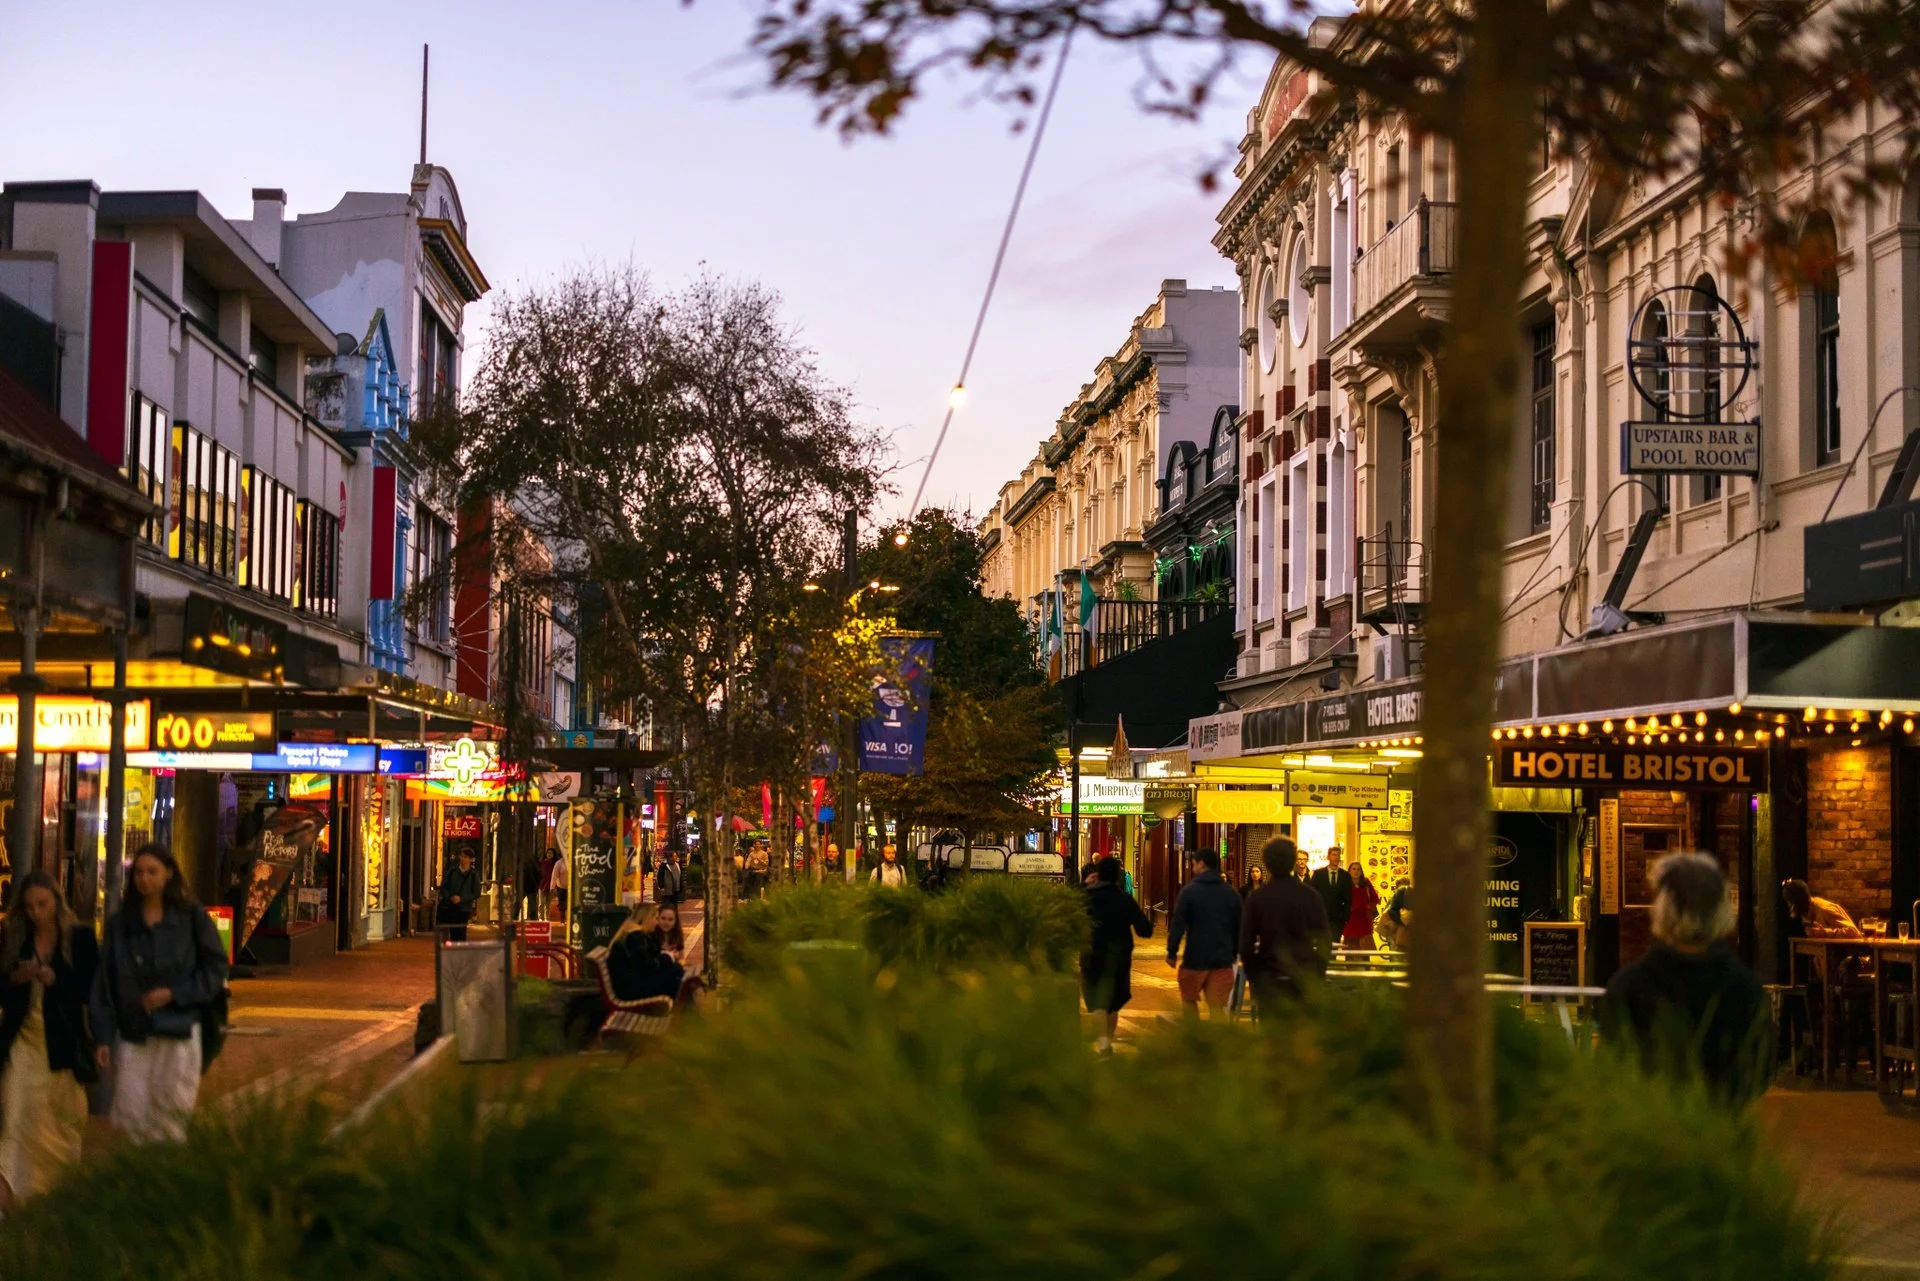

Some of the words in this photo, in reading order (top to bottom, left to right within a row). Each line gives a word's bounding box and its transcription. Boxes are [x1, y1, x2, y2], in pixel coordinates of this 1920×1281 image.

[1633, 429, 1703, 444] UPSTAIRS
[1708, 430, 1739, 444] BAR
[1744, 432, 1754, 444] &
[1640, 449, 1687, 465] POOL
[1695, 450, 1747, 465] ROOM
[1367, 696, 1395, 727] HOTEL
[1396, 691, 1422, 723] BRIST
[280, 747, 318, 757] Passport
[319, 747, 348, 757] Photos
[865, 741, 887, 752] VISA
[287, 757, 311, 768] Open
[1513, 751, 1612, 779] HOTEL
[1623, 753, 1751, 783] BRISTOL
[455, 820, 476, 830] LAZ
[581, 843, 599, 853] The
[1484, 880, 1520, 891] MING
[1483, 897, 1519, 907] UNGE
[1489, 933, 1518, 941] HINES
